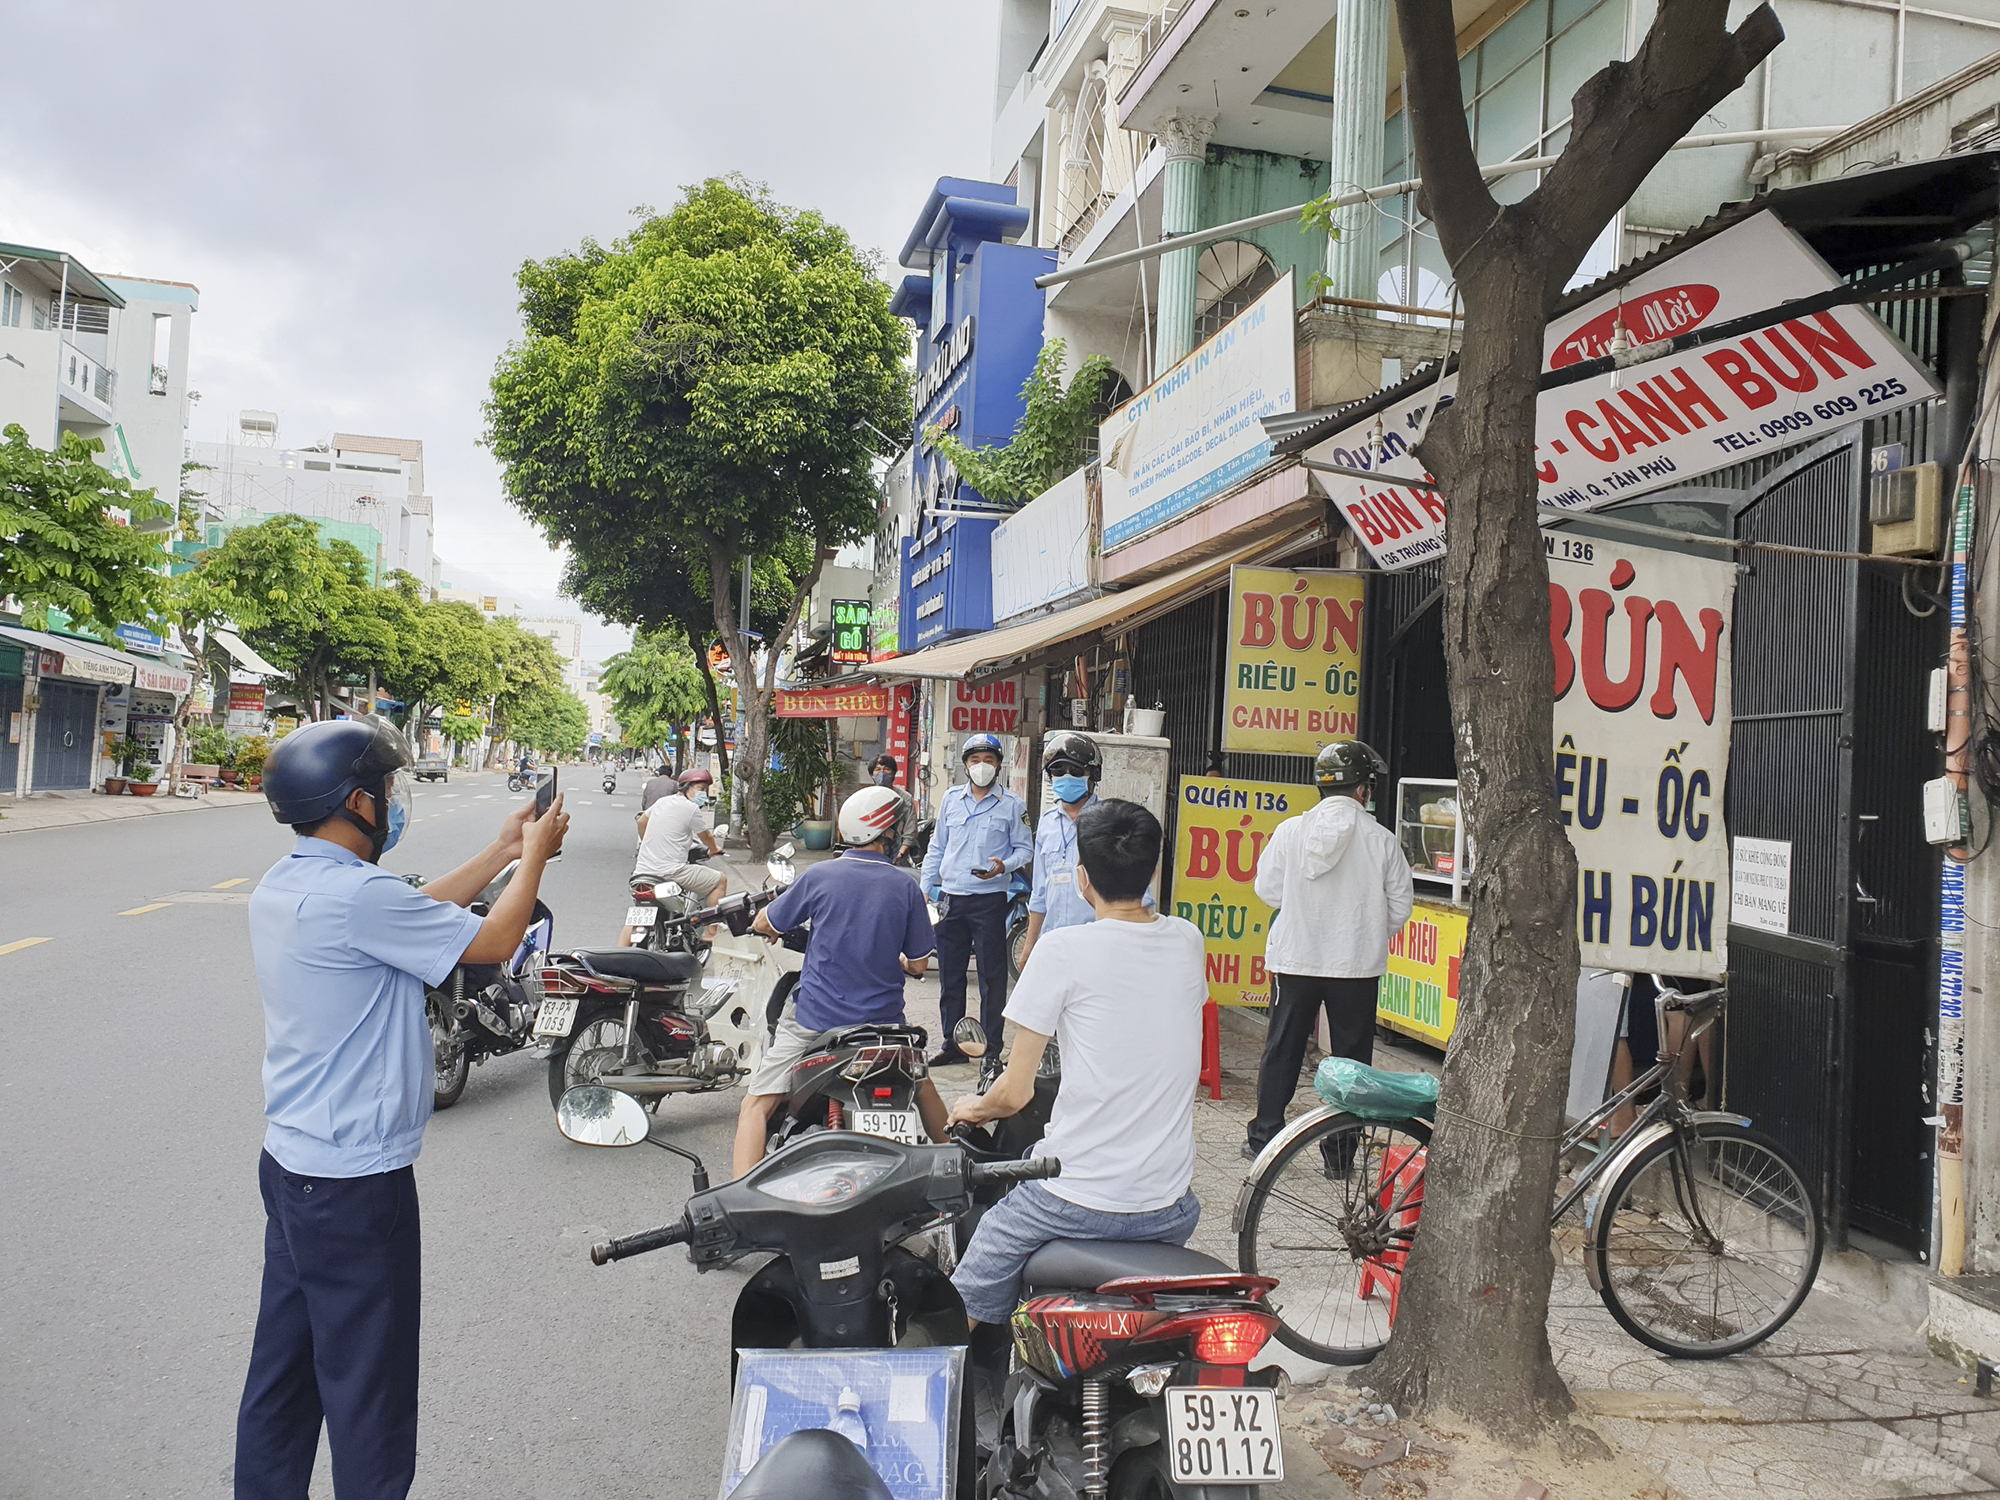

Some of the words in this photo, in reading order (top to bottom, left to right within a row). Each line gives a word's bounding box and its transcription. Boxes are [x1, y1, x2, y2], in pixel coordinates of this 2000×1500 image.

[1642, 290, 1702, 340] Mời
[944, 315, 971, 381] LAND
[1128, 395, 1151, 423] CTY
[1154, 365, 1191, 403] TNHH
[1195, 349, 1209, 374] IN
[1241, 304, 1265, 336] TM
[1564, 366, 1728, 463] CANH
[1712, 429, 1762, 453] TEL:
[1759, 411, 1813, 438] 0909
[1813, 396, 1858, 420] 609
[1858, 378, 1908, 406] 225
[1133, 470, 1141, 481] IN
[1185, 432, 1199, 449] BAO
[1206, 434, 1227, 453] DECAL
[1603, 470, 1641, 491] TÂN
[1637, 454, 1677, 480] PHÚ
[1346, 484, 1424, 546] BÚN
[1381, 550, 1400, 567] 136
[1561, 539, 1594, 561] 136
[836, 604, 868, 625] SÀN
[1239, 578, 1365, 656] BÚN
[840, 627, 863, 650] GỖ
[1237, 659, 1296, 693] RIÊU
[1325, 662, 1358, 697] ỐC
[783, 692, 828, 712] BÚN
[834, 691, 886, 711] RIÊU
[952, 707, 1019, 732] CHAY
[1231, 704, 1299, 732] CANH
[1307, 704, 1357, 736] BÚN
[1184, 785, 1248, 810] QUÁN
[1254, 791, 1289, 813] 136
[1555, 734, 1608, 831] ÊU
[1656, 742, 1712, 843] ỐC
[1185, 815, 1272, 884] BÚ
[1176, 893, 1248, 939] RIÊU
[1629, 859, 1716, 953] BÚN
[1744, 892, 1757, 908] BÁN
[1757, 897, 1777, 913] MANG
[1408, 916, 1438, 967] RIÊU
[1205, 953, 1240, 984] NH
[1379, 973, 1411, 1018] CANH
[1414, 977, 1442, 1028] BÚN
[538, 1016, 565, 1032] 1059
[863, 1114, 907, 1133] 59-D2
[1183, 1394, 1262, 1432] 59-X2
[1177, 1437, 1277, 1475] 801.12
